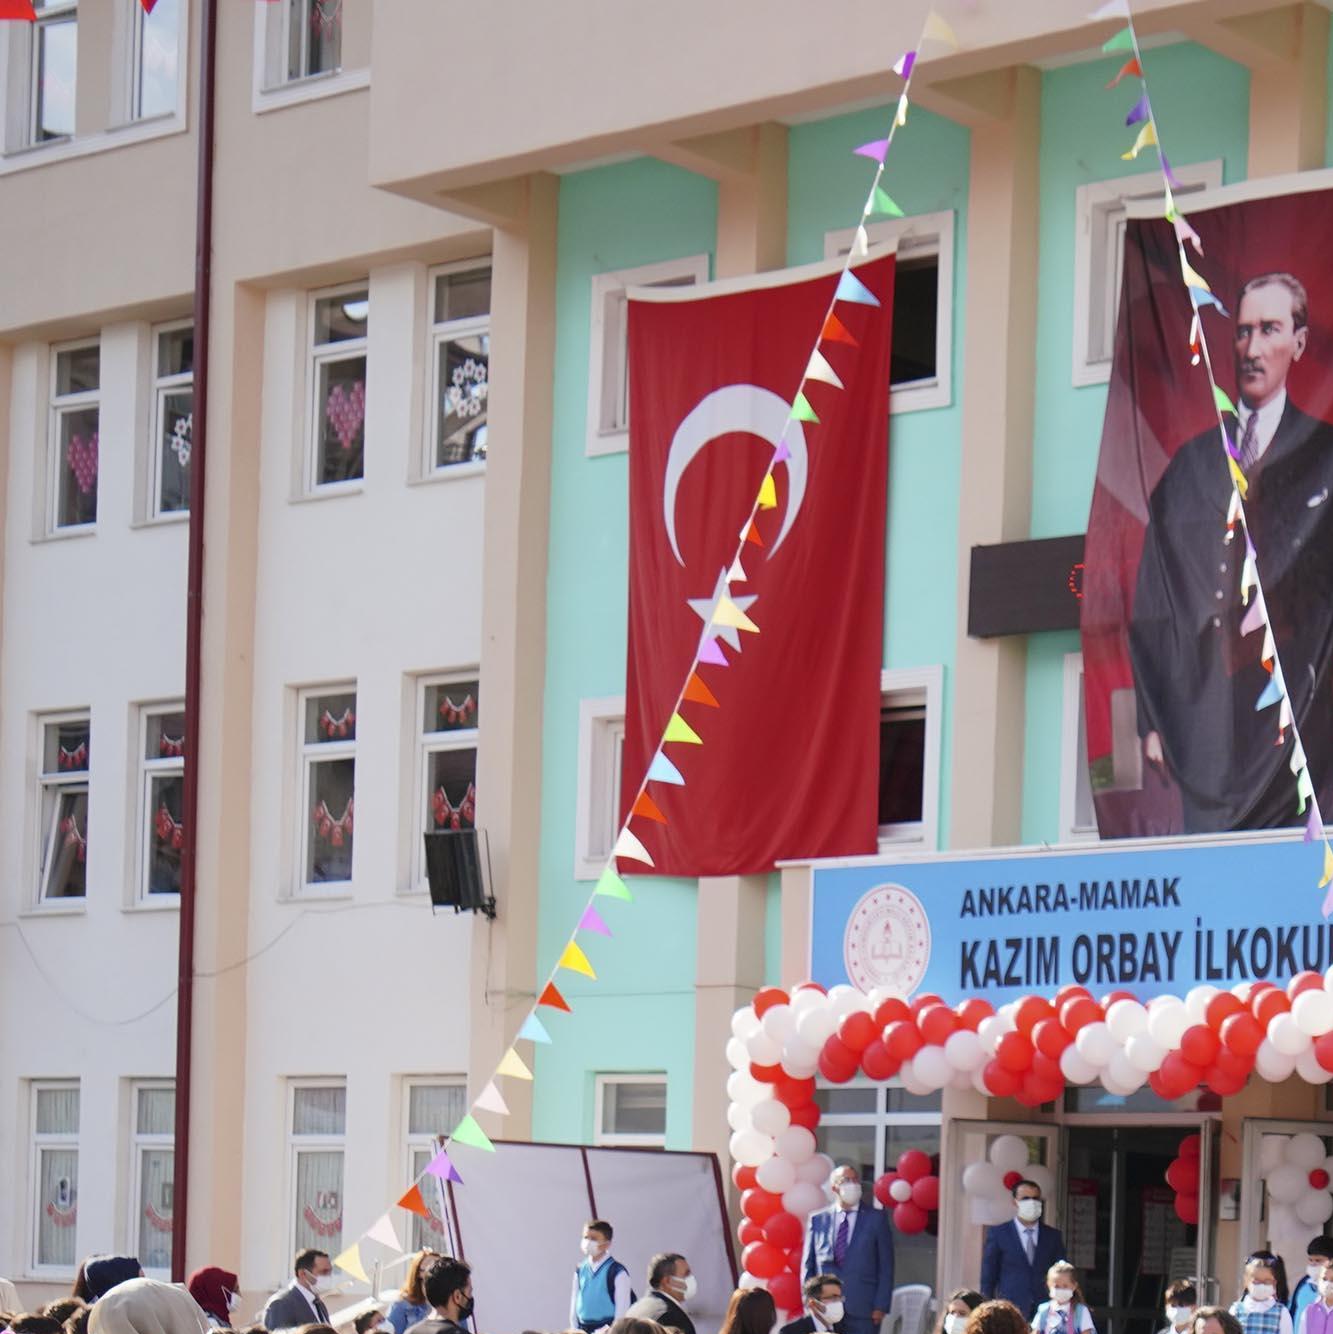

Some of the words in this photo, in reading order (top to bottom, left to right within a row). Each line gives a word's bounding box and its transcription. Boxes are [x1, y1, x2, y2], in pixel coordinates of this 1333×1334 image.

[960, 877, 1181, 918] ANKARA-MAMAK
[960, 936, 1060, 989] KAZIM
[1072, 931, 1183, 984] ORBAY
